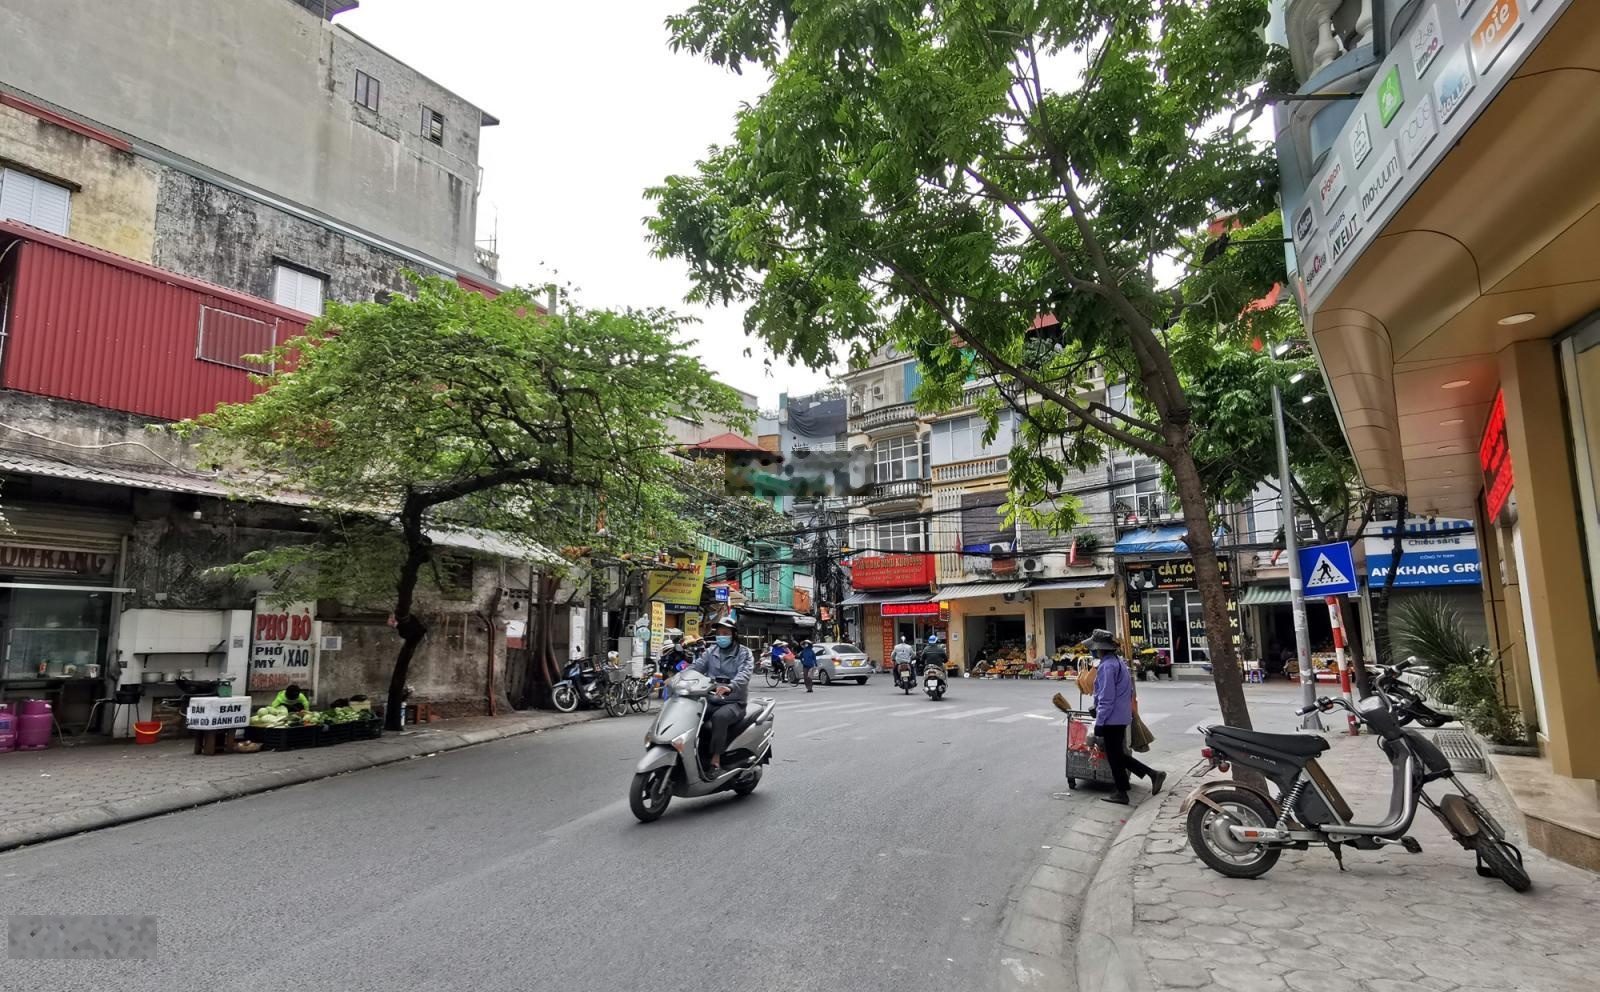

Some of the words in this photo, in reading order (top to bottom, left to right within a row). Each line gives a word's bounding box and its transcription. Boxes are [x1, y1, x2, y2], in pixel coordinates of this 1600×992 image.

[1321, 163, 1341, 201] pigeon
[1329, 210, 1346, 238] PHILIPS
[1396, 564, 1450, 576] KHANG
[1225, 598, 1237, 611] ẮT
[255, 607, 289, 641] PHỞ
[255, 643, 283, 655] PHỞ
